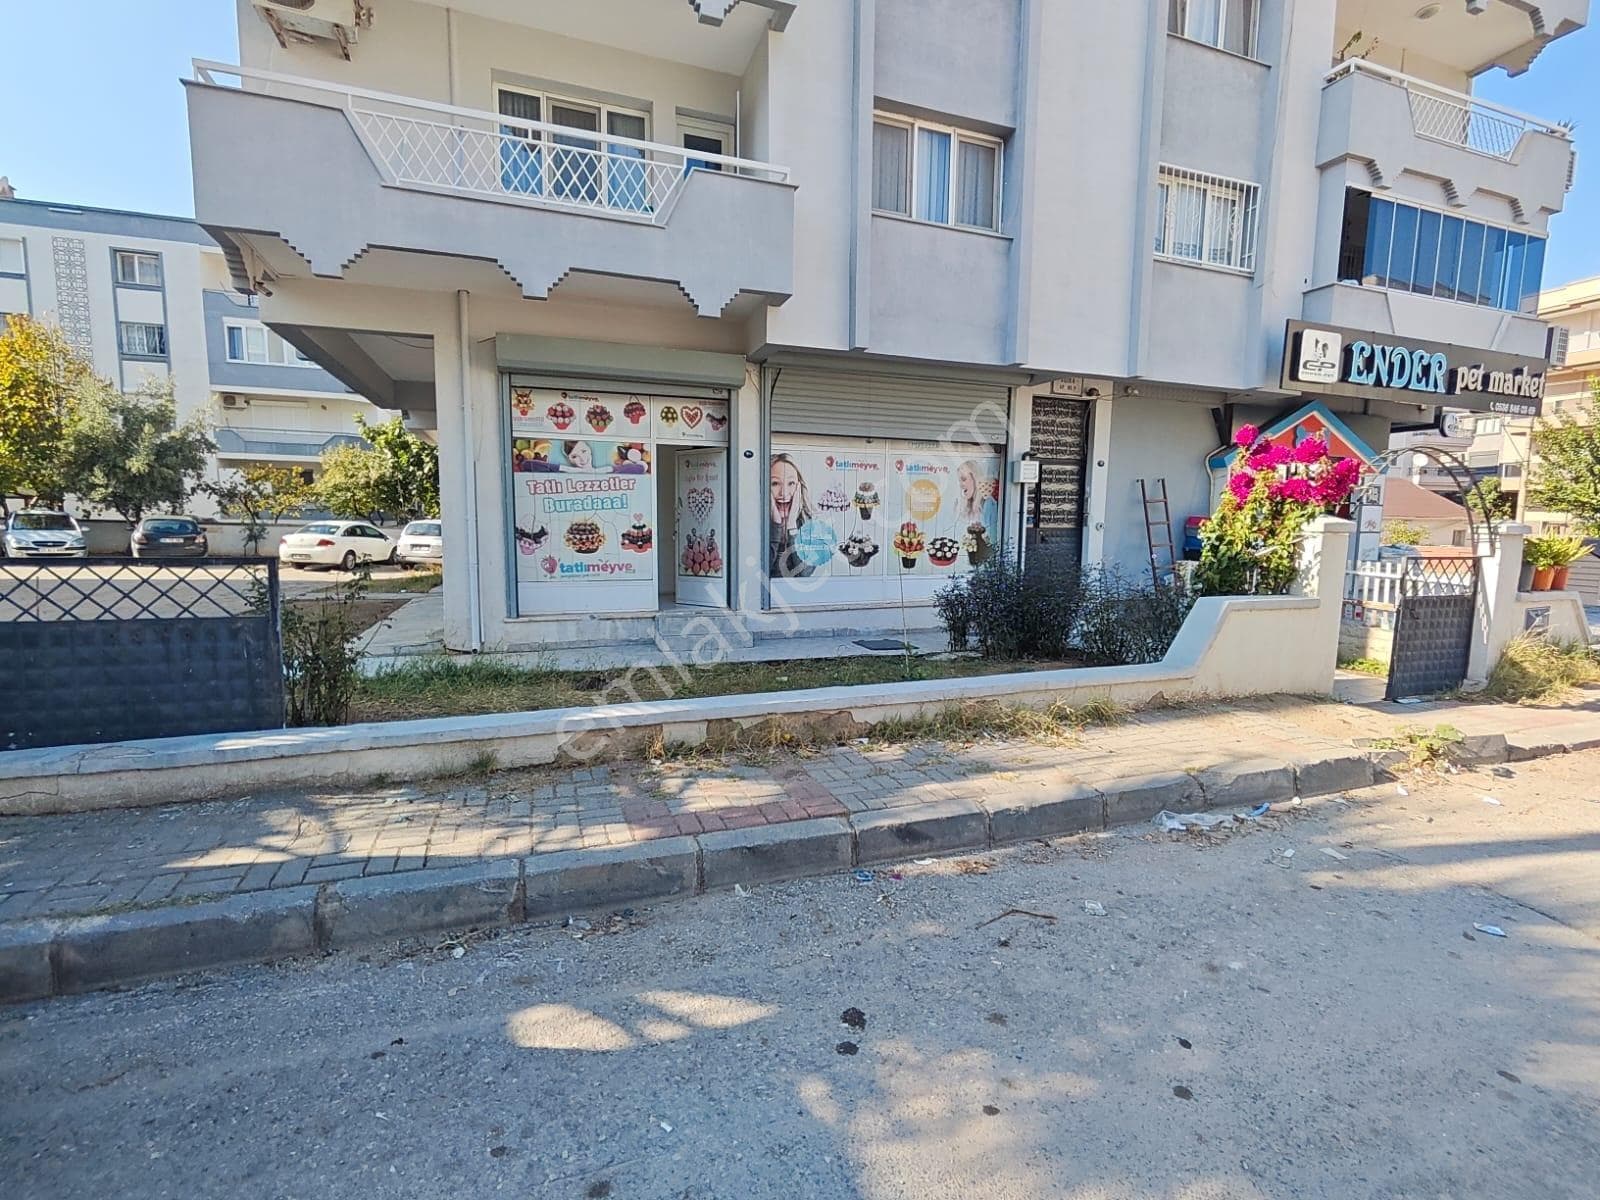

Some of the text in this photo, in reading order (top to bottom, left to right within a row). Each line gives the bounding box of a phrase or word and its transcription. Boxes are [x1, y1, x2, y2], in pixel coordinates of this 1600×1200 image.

[1349, 340, 1545, 399] ENDER pet market
[526, 477, 636, 495] Tatlı Lezzetler
[543, 494, 628, 513] Buradaaa!
